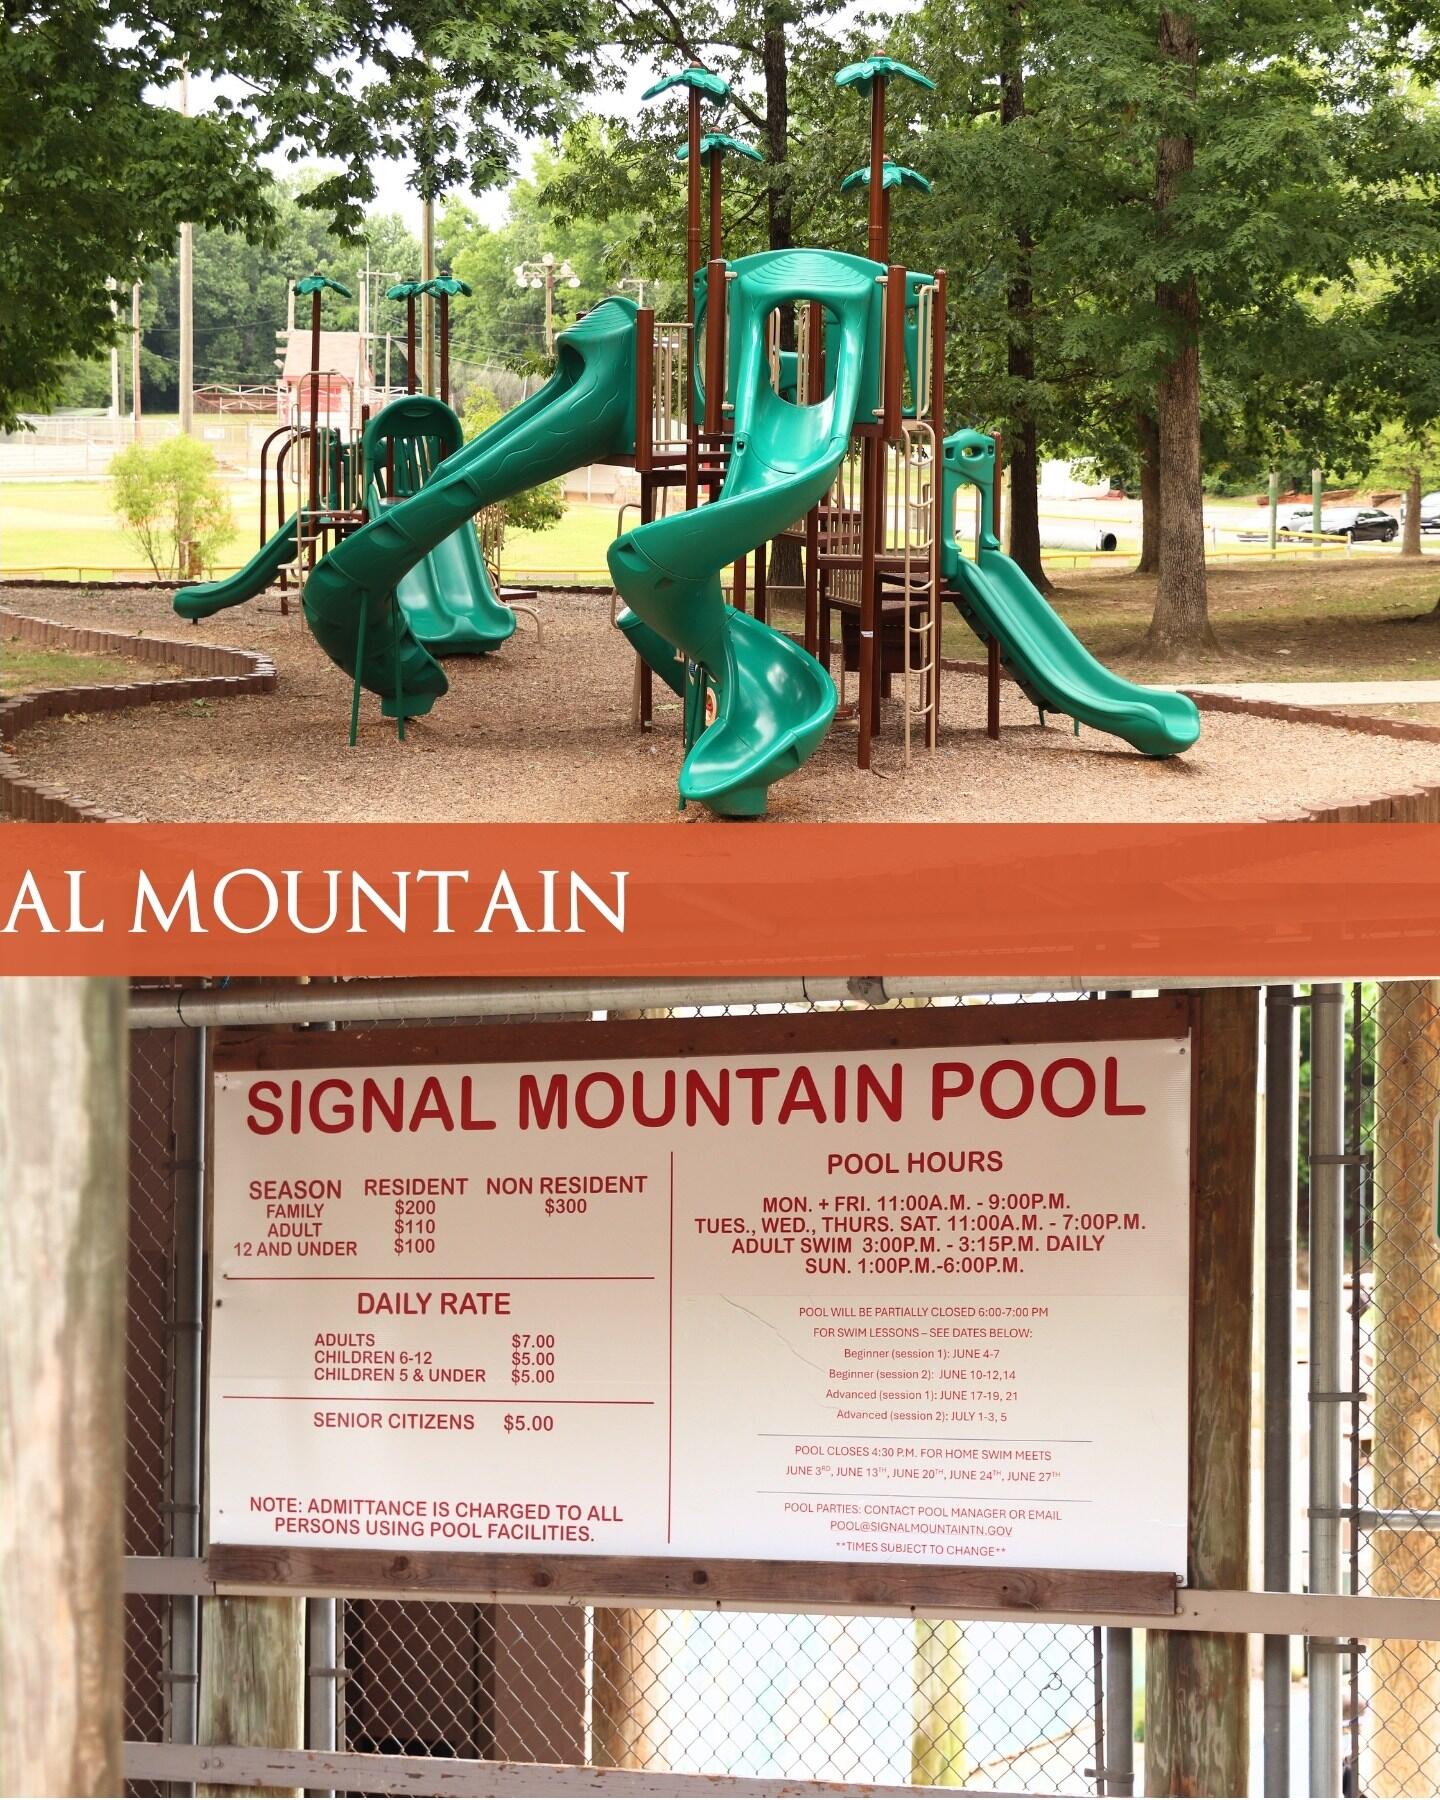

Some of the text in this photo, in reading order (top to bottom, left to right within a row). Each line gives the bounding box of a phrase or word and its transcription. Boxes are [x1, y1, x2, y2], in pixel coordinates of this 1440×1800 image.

[247, 1057, 1146, 1135] SIGNAL MOUNTAIN POOL
[828, 1151, 1002, 1174] POOL HOURS
[250, 1176, 647, 1200] SEASON RESIDENT NON RESIDENT
[267, 1198, 586, 1219] FAMILY $200 $300
[764, 1197, 812, 1212] MON.
[819, 1199, 829, 1210] +
[836, 1196, 870, 1211] FRI.
[878, 1195, 970, 1211] 11:00A.M.
[989, 1193, 1070, 1209] 9:00P.M.
[268, 1218, 435, 1237] ADULT $110
[695, 1218, 755, 1236] TUES.,
[761, 1218, 815, 1236] WED.,
[822, 1216, 893, 1232] THURS.
[901, 1216, 940, 1231] SAT.
[948, 1215, 1042, 1231] 11:00A.M.
[1063, 1214, 1145, 1230] 7:00P.M.
[234, 1237, 435, 1256] 12 AND UNDER $100
[732, 1238, 795, 1253] ADULT
[801, 1238, 851, 1253] SWIM
[863, 1237, 940, 1253] 3:00P.M.
[959, 1236, 1039, 1252] 3:15P.M.
[1047, 1235, 1104, 1251] DAILY
[806, 1257, 1023, 1273] SUN. 1:00P.M.-6:00P.M.
[358, 1293, 510, 1314] DAILY RATE
[799, 1306, 1049, 1317] POOL WILL BE PARTIALLY CLOSED 6:00-7:00 PM
[813, 1327, 835, 1338] FOR
[837, 1327, 867, 1338] SWIM
[869, 1327, 920, 1338] LESSONS
[929, 1327, 950, 1338] SEE
[952, 1327, 987, 1338] DATES
[989, 1328, 1033, 1338] BELOW:
[315, 1334, 554, 1352] ADULTS $7.00
[315, 1351, 554, 1370] CHILDREN 6-12 $5.00
[844, 1348, 1000, 1361] Beginner (session 1): JUNE 4-7
[315, 1368, 554, 1385] CHILDREN 5 & UNDER $5.00
[829, 1368, 874, 1381] Beginner
[876, 1369, 919, 1381] (session
[921, 1369, 934, 1381] 2):
[938, 1369, 967, 1380] JUNE
[825, 1388, 1017, 1402] Advanced (session 1): JUNE 17-19, 21
[314, 1412, 553, 1433] SENIOR CITIZENS $5.00
[836, 1409, 1008, 1423] Advanced (session 2): JULY 1-3, 5
[795, 1445, 1052, 1461] POOL CLOSES 4:30 P.M. FOR HOME SWIM MEETS
[786, 1465, 813, 1476] JUNE
[836, 1466, 863, 1477] JUNE
[891, 1468, 920, 1479] JUNE
[949, 1469, 977, 1480] JUNE
[1007, 1471, 1036, 1482] JUNE
[251, 1497, 623, 1521] NOTE: ADMITTANCE IS CHARGED TO ALL
[784, 1502, 1063, 1521] POOL PARTIES: CONTACT POOL MANAGER OR EMAIL
[276, 1517, 594, 1541] PERSONS USING POOL FACILITIES.
[880, 1542, 928, 1554] SUBJECT
[929, 1544, 944, 1555] TO
